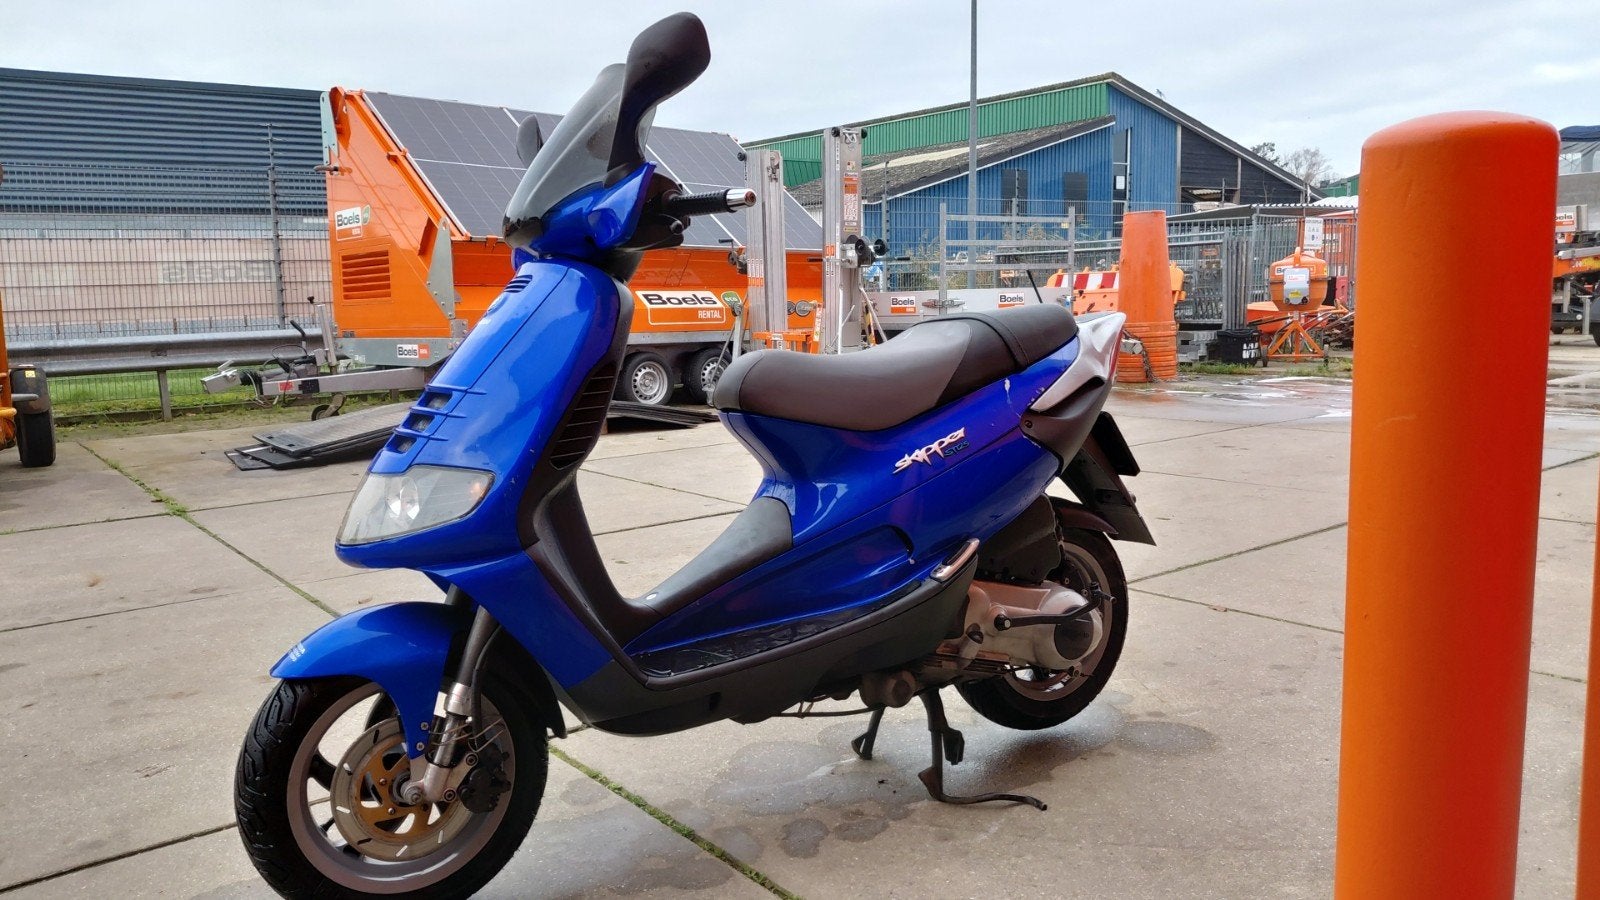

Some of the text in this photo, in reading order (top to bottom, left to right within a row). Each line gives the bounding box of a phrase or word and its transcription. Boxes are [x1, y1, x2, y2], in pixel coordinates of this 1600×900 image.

[337, 212, 360, 227] Boels
[642, 293, 717, 305] Boels
[891, 297, 915, 306] Boels
[999, 294, 1024, 303] Boels
[697, 310, 722, 319] RENTAL
[397, 346, 418, 356] Boels
